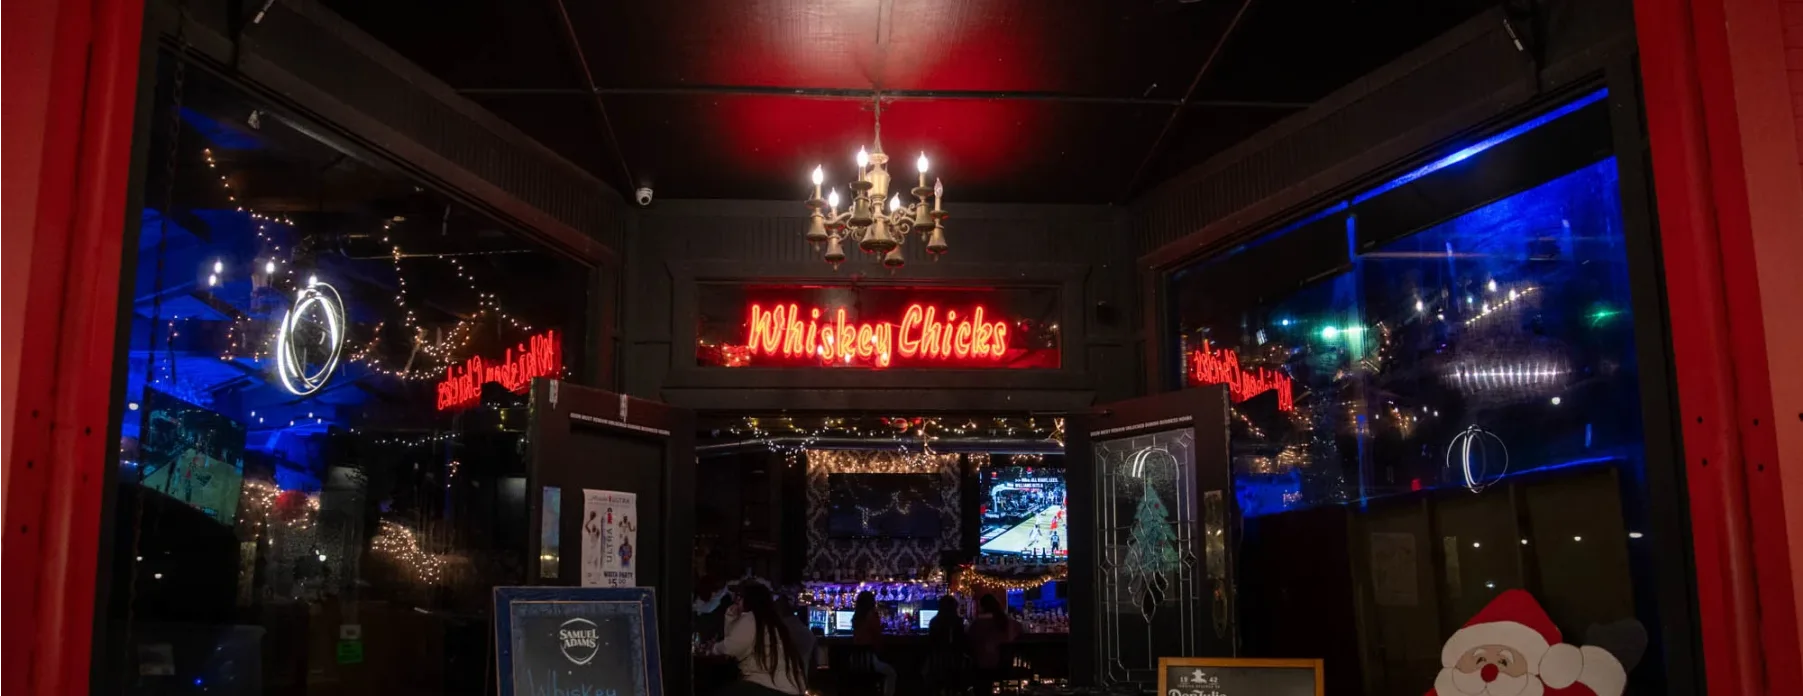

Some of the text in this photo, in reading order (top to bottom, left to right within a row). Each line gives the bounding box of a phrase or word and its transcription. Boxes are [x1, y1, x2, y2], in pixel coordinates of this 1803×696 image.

[749, 303, 1008, 367] Whiskey Chicks
[560, 629, 600, 640] SAMUEL
[563, 639, 597, 649] ADAMS
